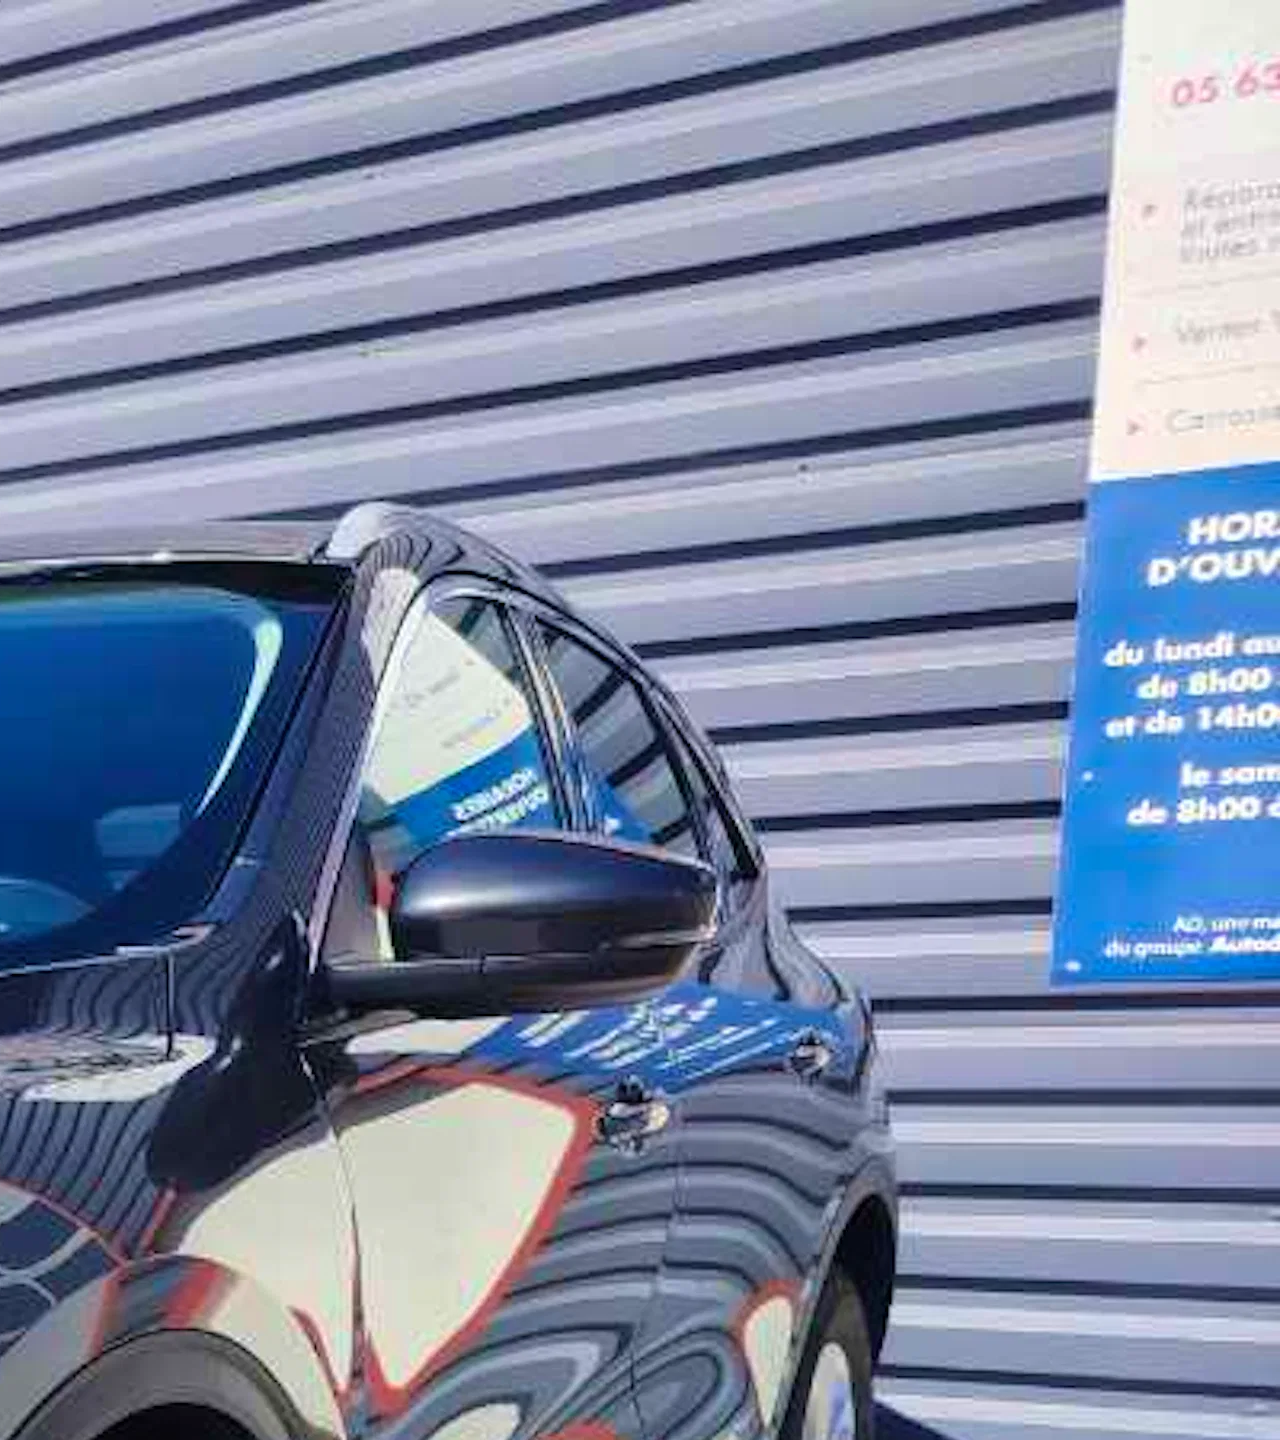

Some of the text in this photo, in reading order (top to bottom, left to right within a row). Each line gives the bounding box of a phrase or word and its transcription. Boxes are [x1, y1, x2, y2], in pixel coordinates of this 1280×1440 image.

[1171, 76, 1220, 109] 05
[1187, 509, 1280, 546] HOR
[1147, 547, 1280, 587] D'OUV
[1103, 640, 1144, 668] du
[1153, 629, 1235, 663] lundi
[1137, 666, 1272, 700] de 8h00
[1105, 701, 1280, 738] et de 14h0
[1180, 760, 1280, 788] le sam
[1126, 798, 1169, 826] de
[1175, 796, 1261, 824] 8h00
